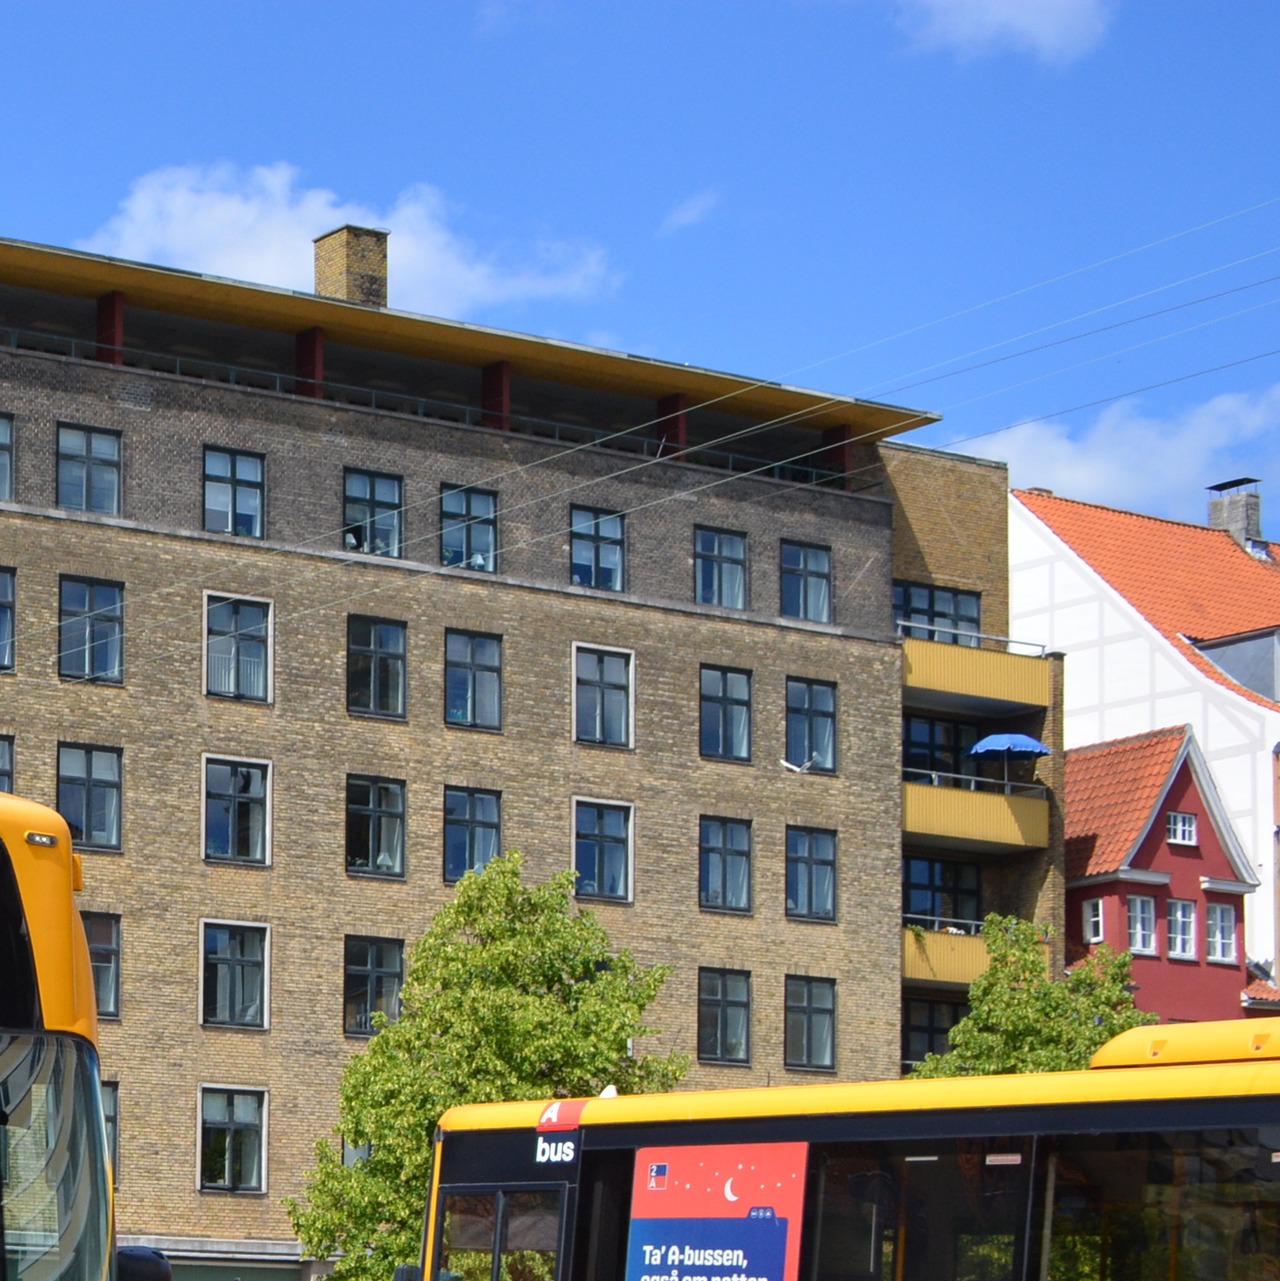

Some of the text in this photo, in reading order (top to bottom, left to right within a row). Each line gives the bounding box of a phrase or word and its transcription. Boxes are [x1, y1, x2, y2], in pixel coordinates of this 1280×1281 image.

[540, 1102, 561, 1123] A
[536, 1136, 575, 1162] bus
[667, 1245, 748, 1269] A-bussen,
